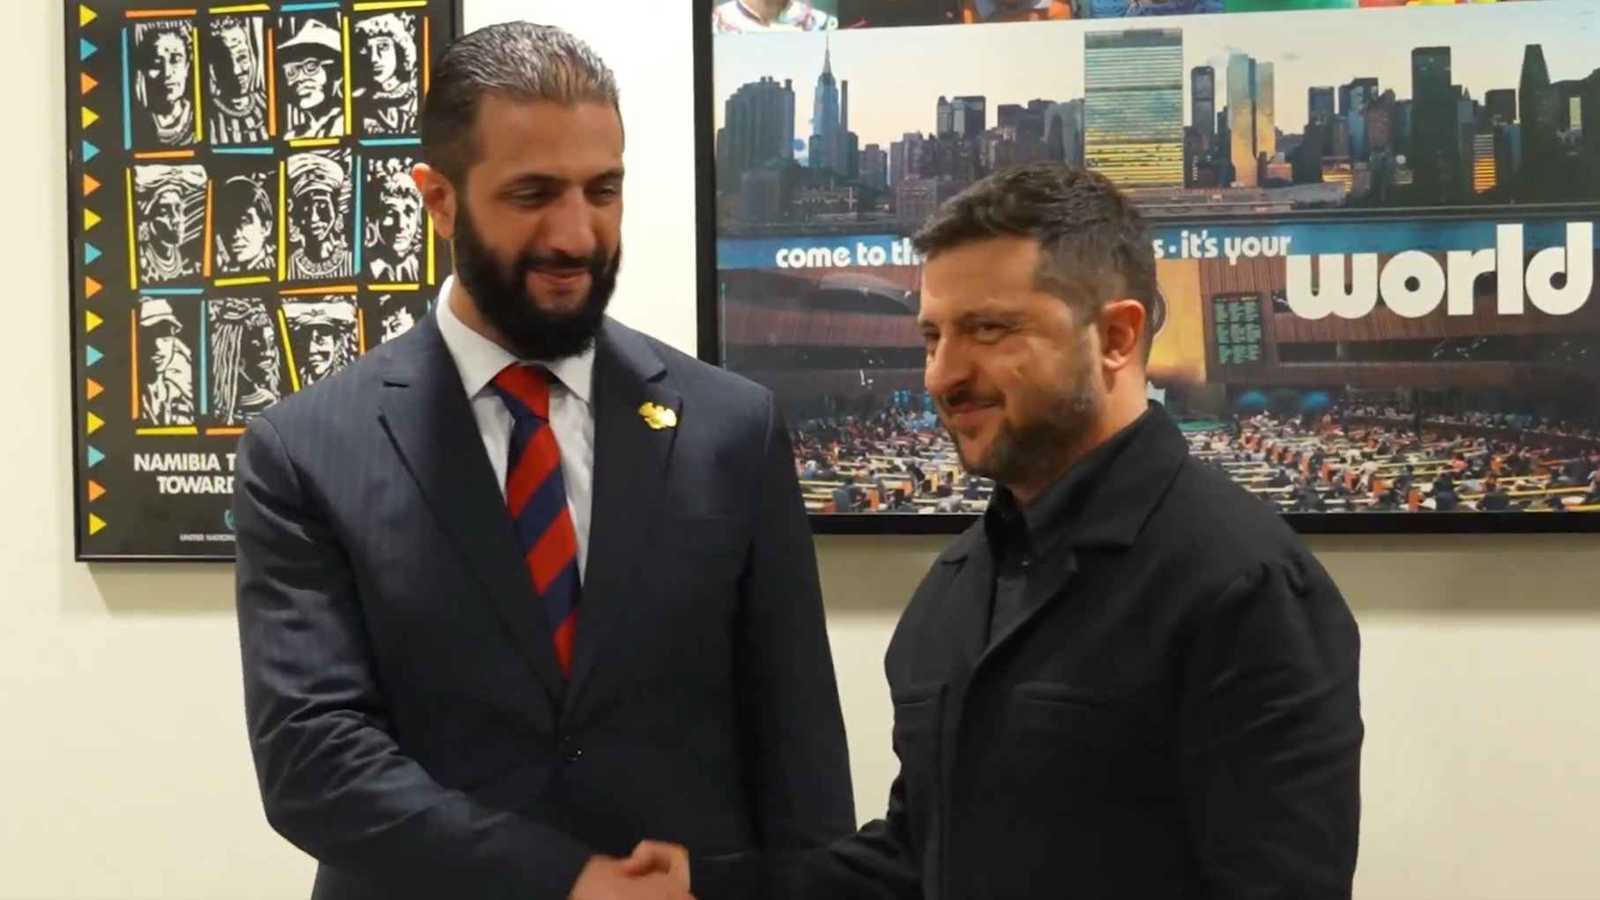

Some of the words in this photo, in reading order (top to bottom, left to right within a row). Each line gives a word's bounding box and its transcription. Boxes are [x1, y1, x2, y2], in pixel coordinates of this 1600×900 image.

[776, 246, 850, 268] come
[857, 242, 886, 266] to
[892, 237, 925, 266] th
[1181, 230, 1218, 258] it's
[1224, 236, 1291, 266] your
[1286, 221, 1593, 319] world
[134, 453, 220, 471] NAMIBIA
